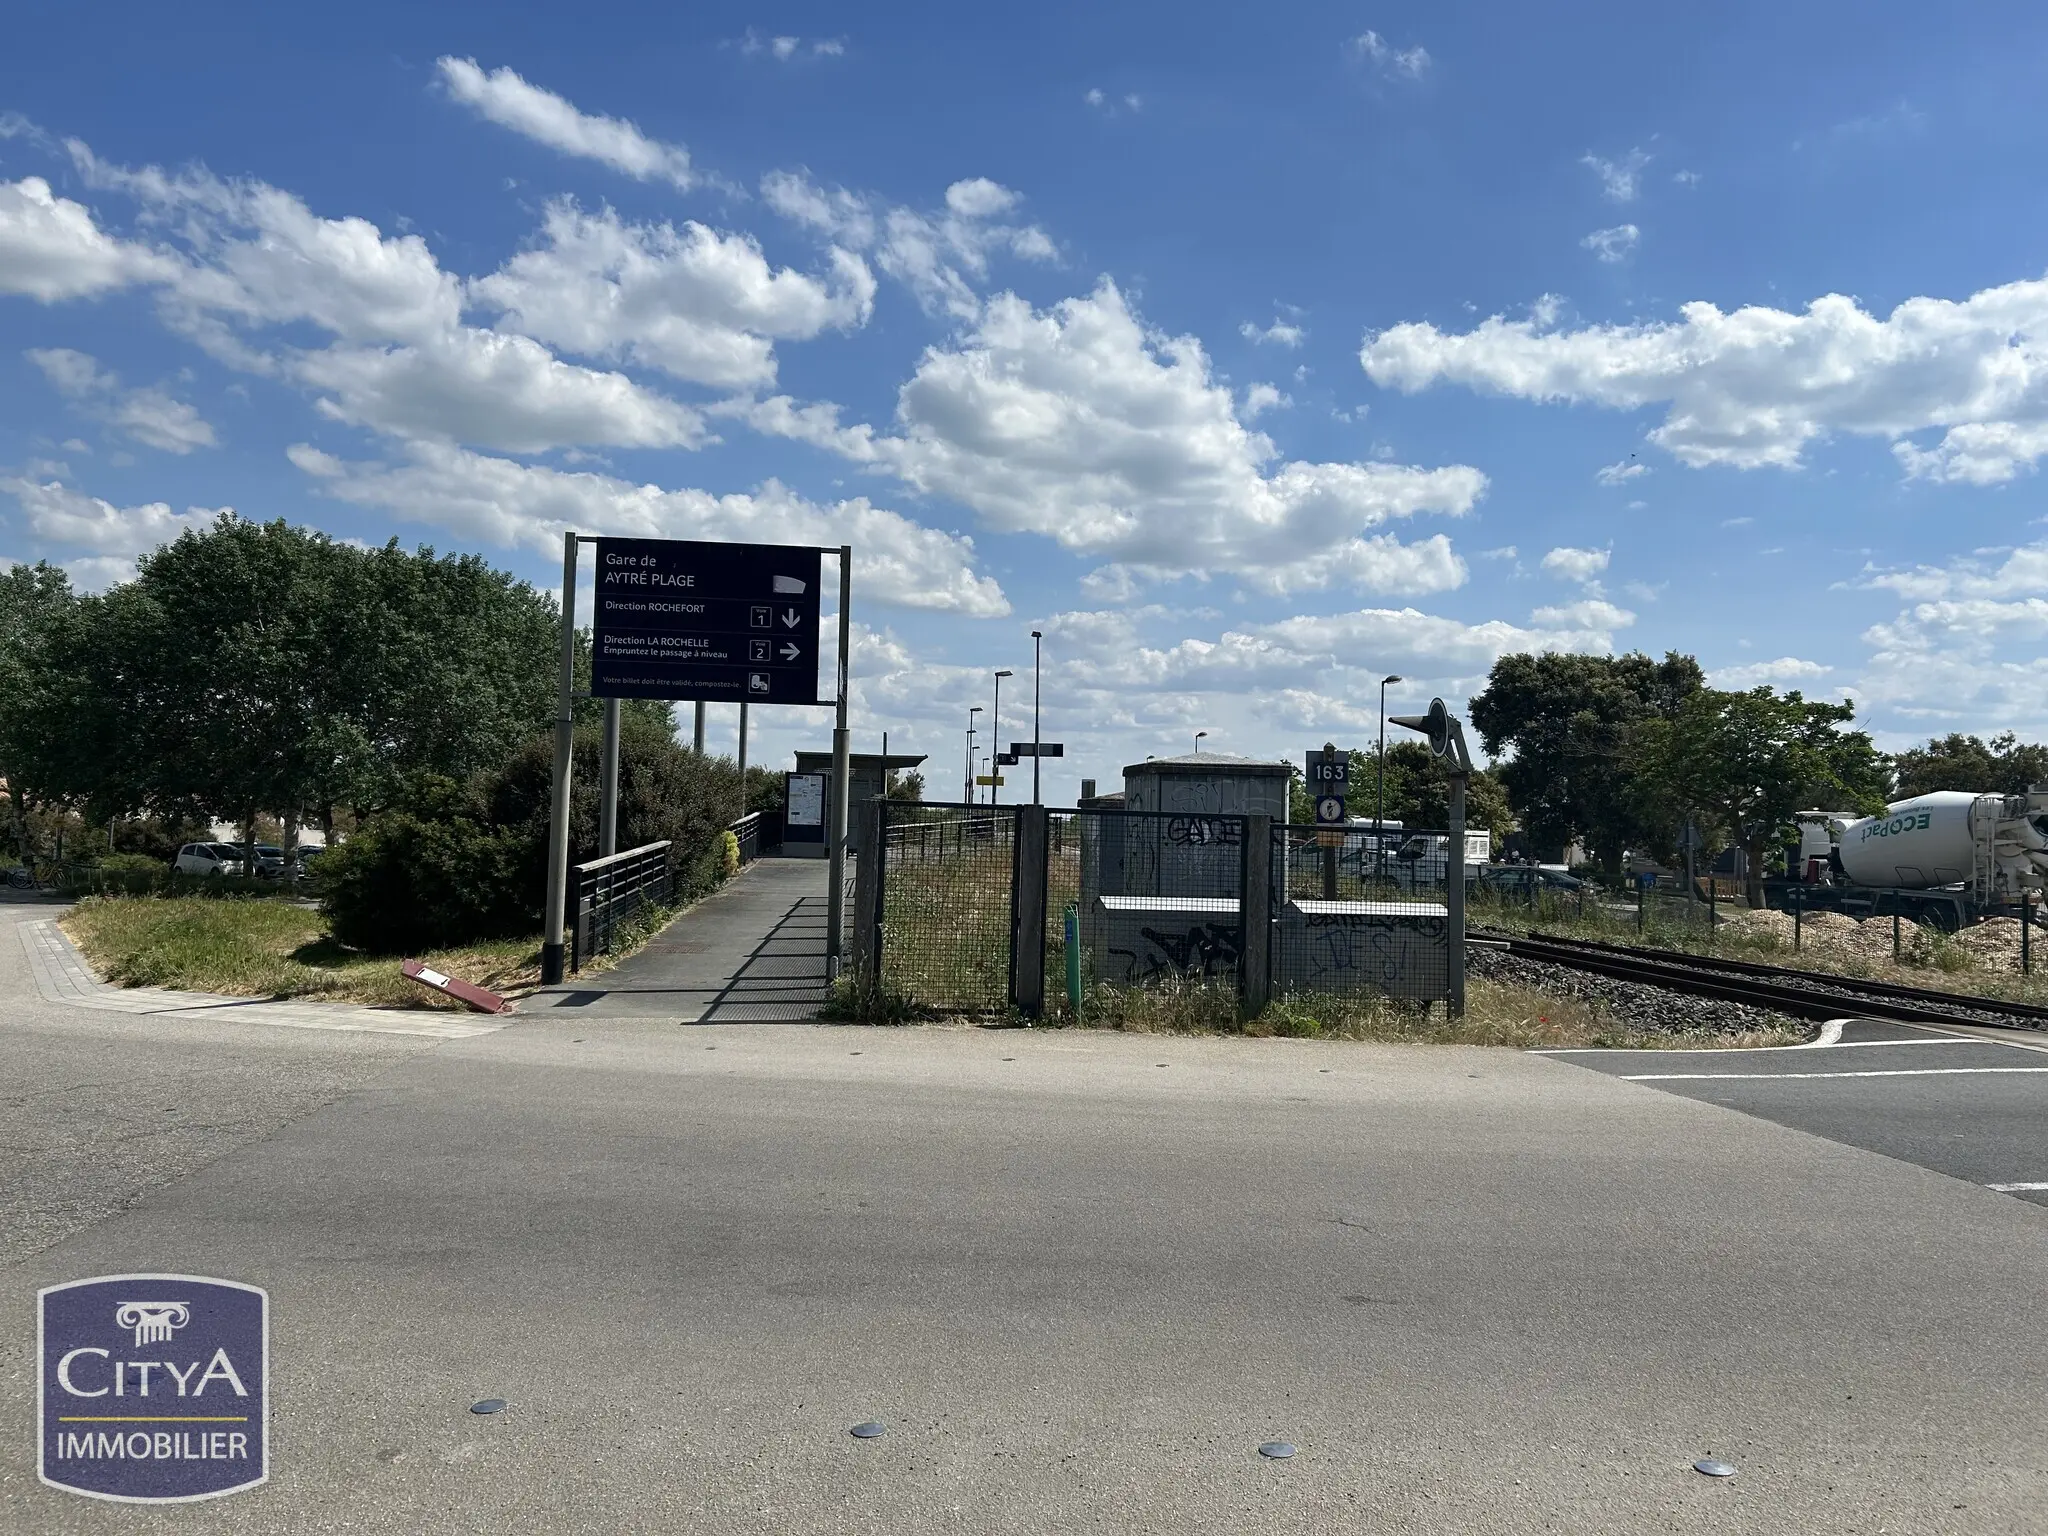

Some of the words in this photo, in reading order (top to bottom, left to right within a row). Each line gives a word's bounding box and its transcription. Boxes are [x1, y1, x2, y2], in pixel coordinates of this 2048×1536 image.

[606, 553, 637, 566] Gare
[640, 554, 657, 567] de
[605, 570, 648, 585] AYTRÉ
[651, 573, 695, 587] PLAGE
[605, 600, 646, 610] Direction
[648, 602, 705, 614] ROCHEFORT
[758, 615, 764, 625] 1
[604, 635, 645, 645] Direction
[647, 637, 659, 646] LA
[661, 637, 710, 648] ROCHELLE
[603, 646, 649, 656] Empruntez
[650, 648, 659, 656] le
[660, 649, 693, 658] passage
[694, 650, 699, 658] à
[701, 650, 728, 659] niveau
[756, 648, 764, 658] 2
[602, 676, 621, 684] Votre
[656, 678, 670, 686] être
[1316, 765, 1344, 780] 163
